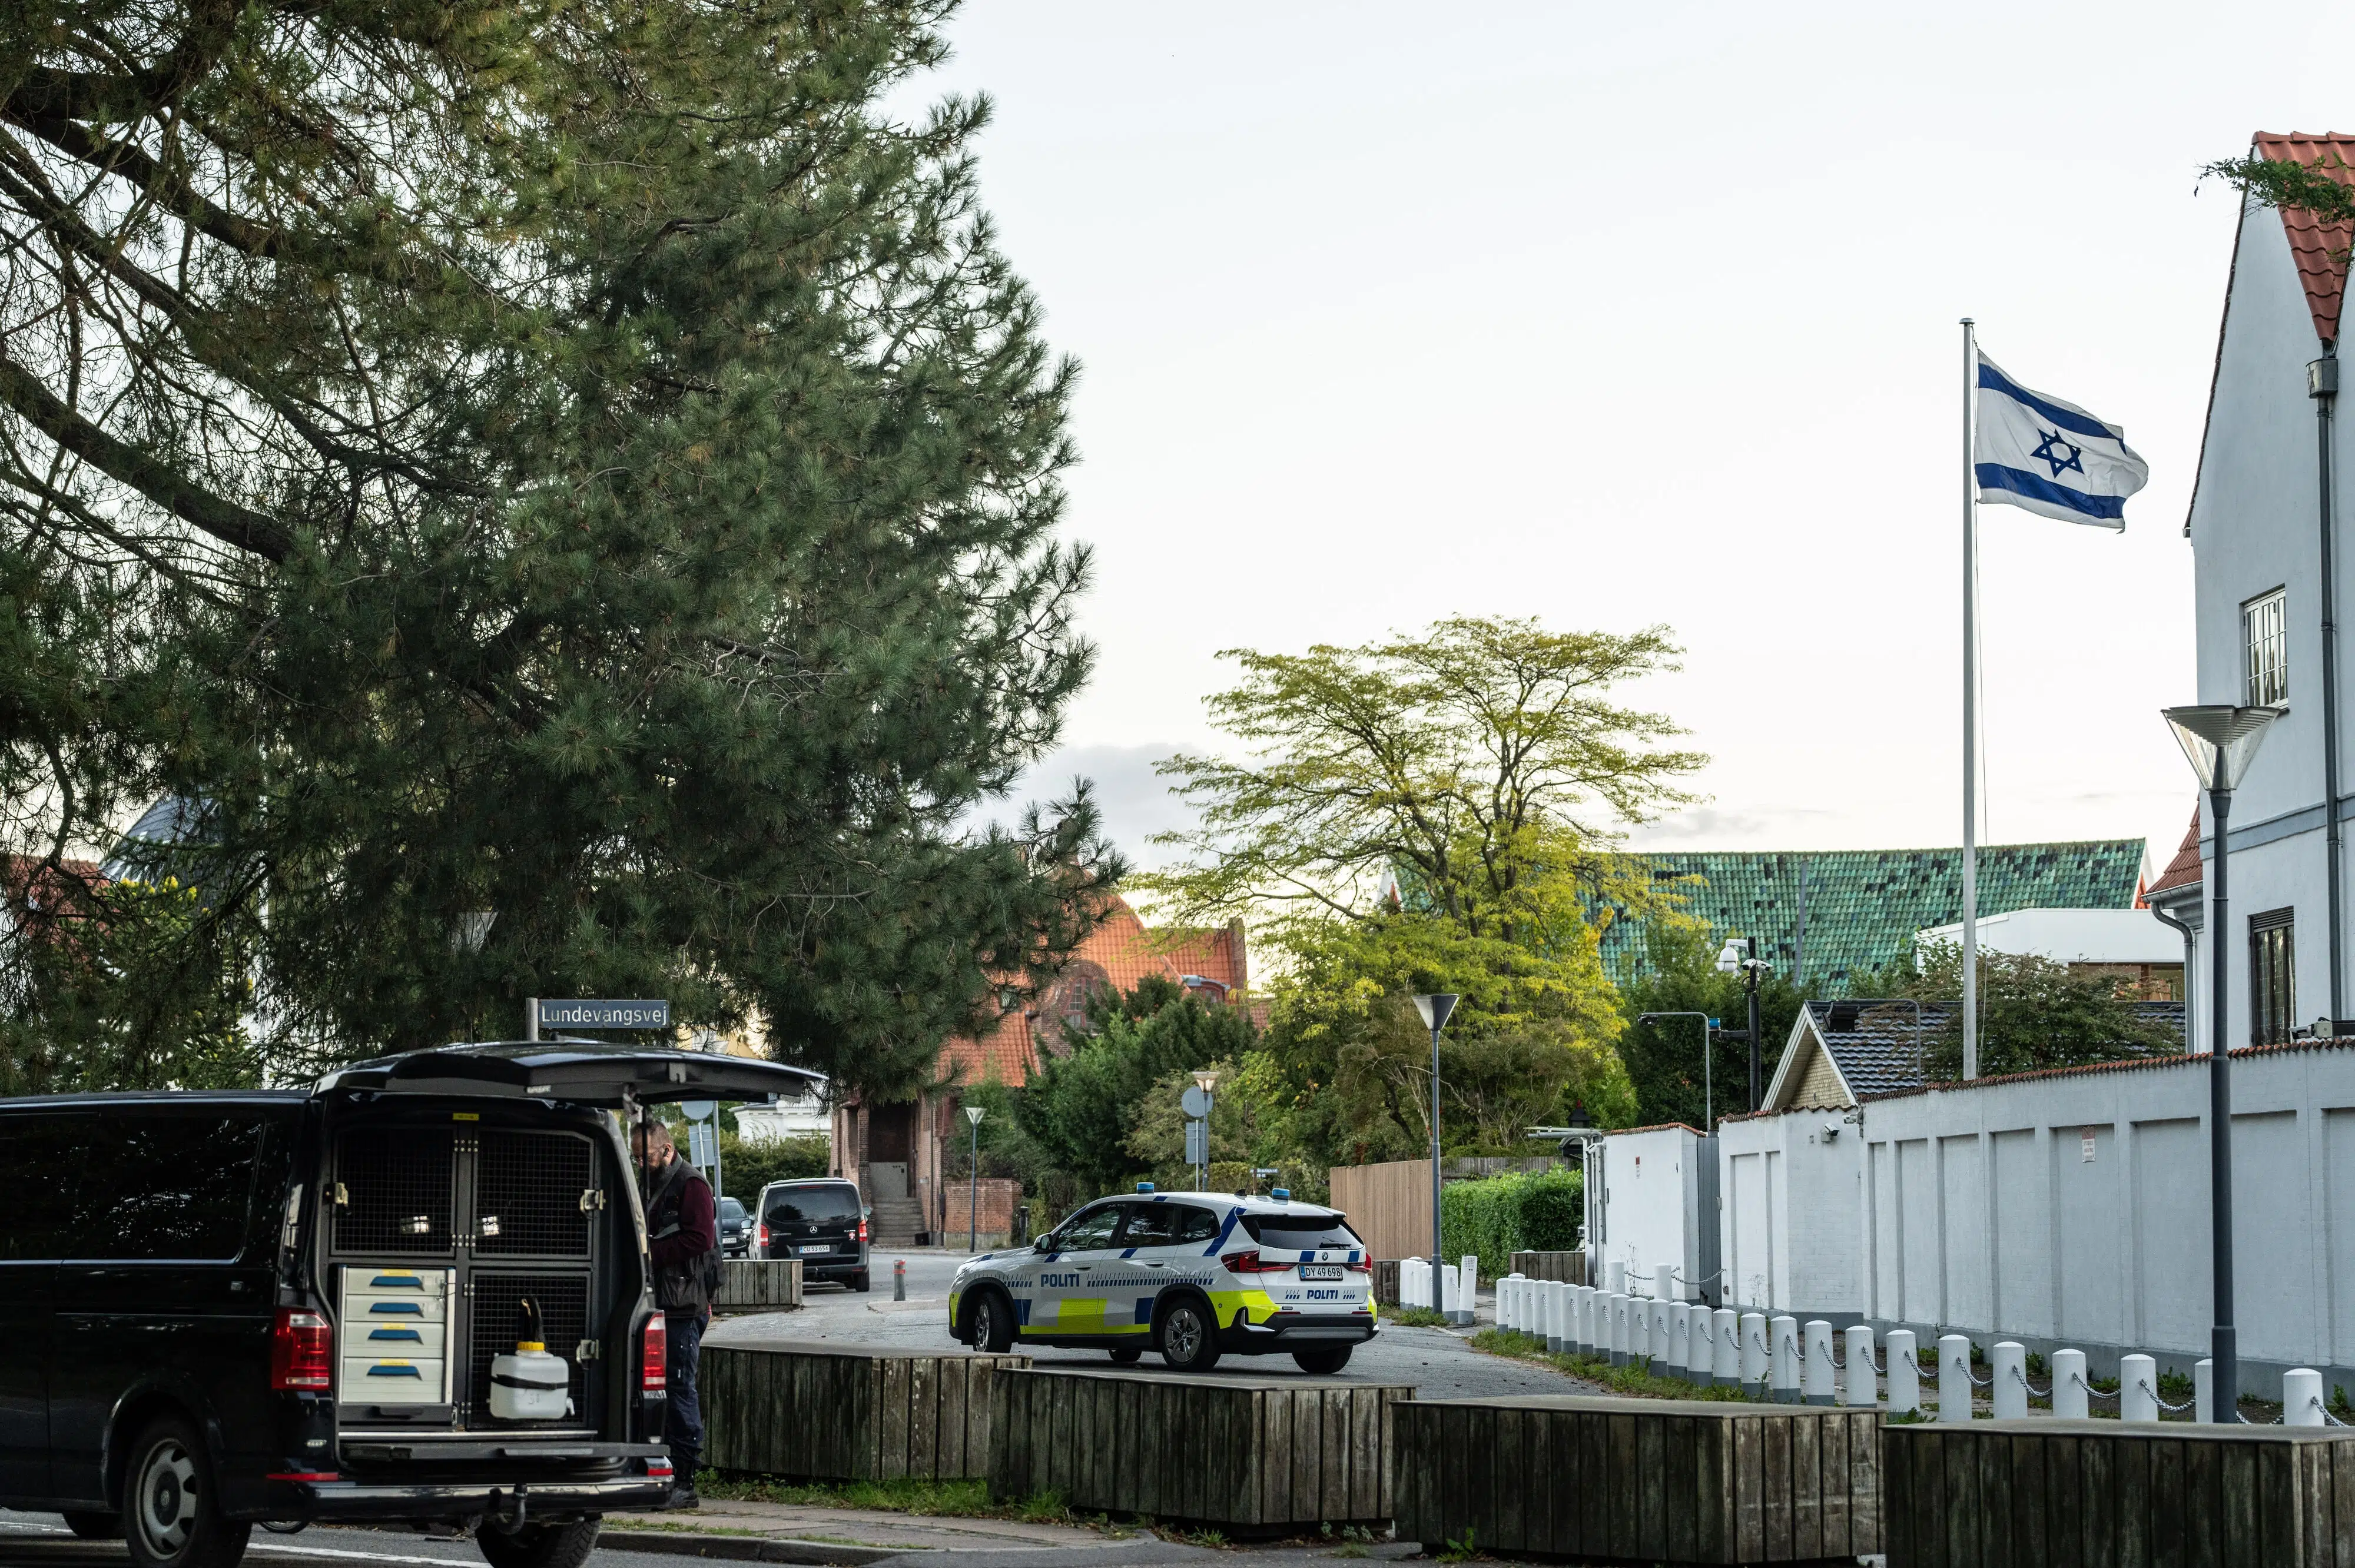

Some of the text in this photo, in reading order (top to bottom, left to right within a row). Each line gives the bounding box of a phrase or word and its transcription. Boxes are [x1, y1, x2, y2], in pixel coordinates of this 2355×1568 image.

[541, 1005, 667, 1026] Lundevangsvej
[1305, 1267, 1341, 1277] DY 49 698
[1040, 1273, 1080, 1287] POLITI
[1306, 1290, 1338, 1300] POLITI
